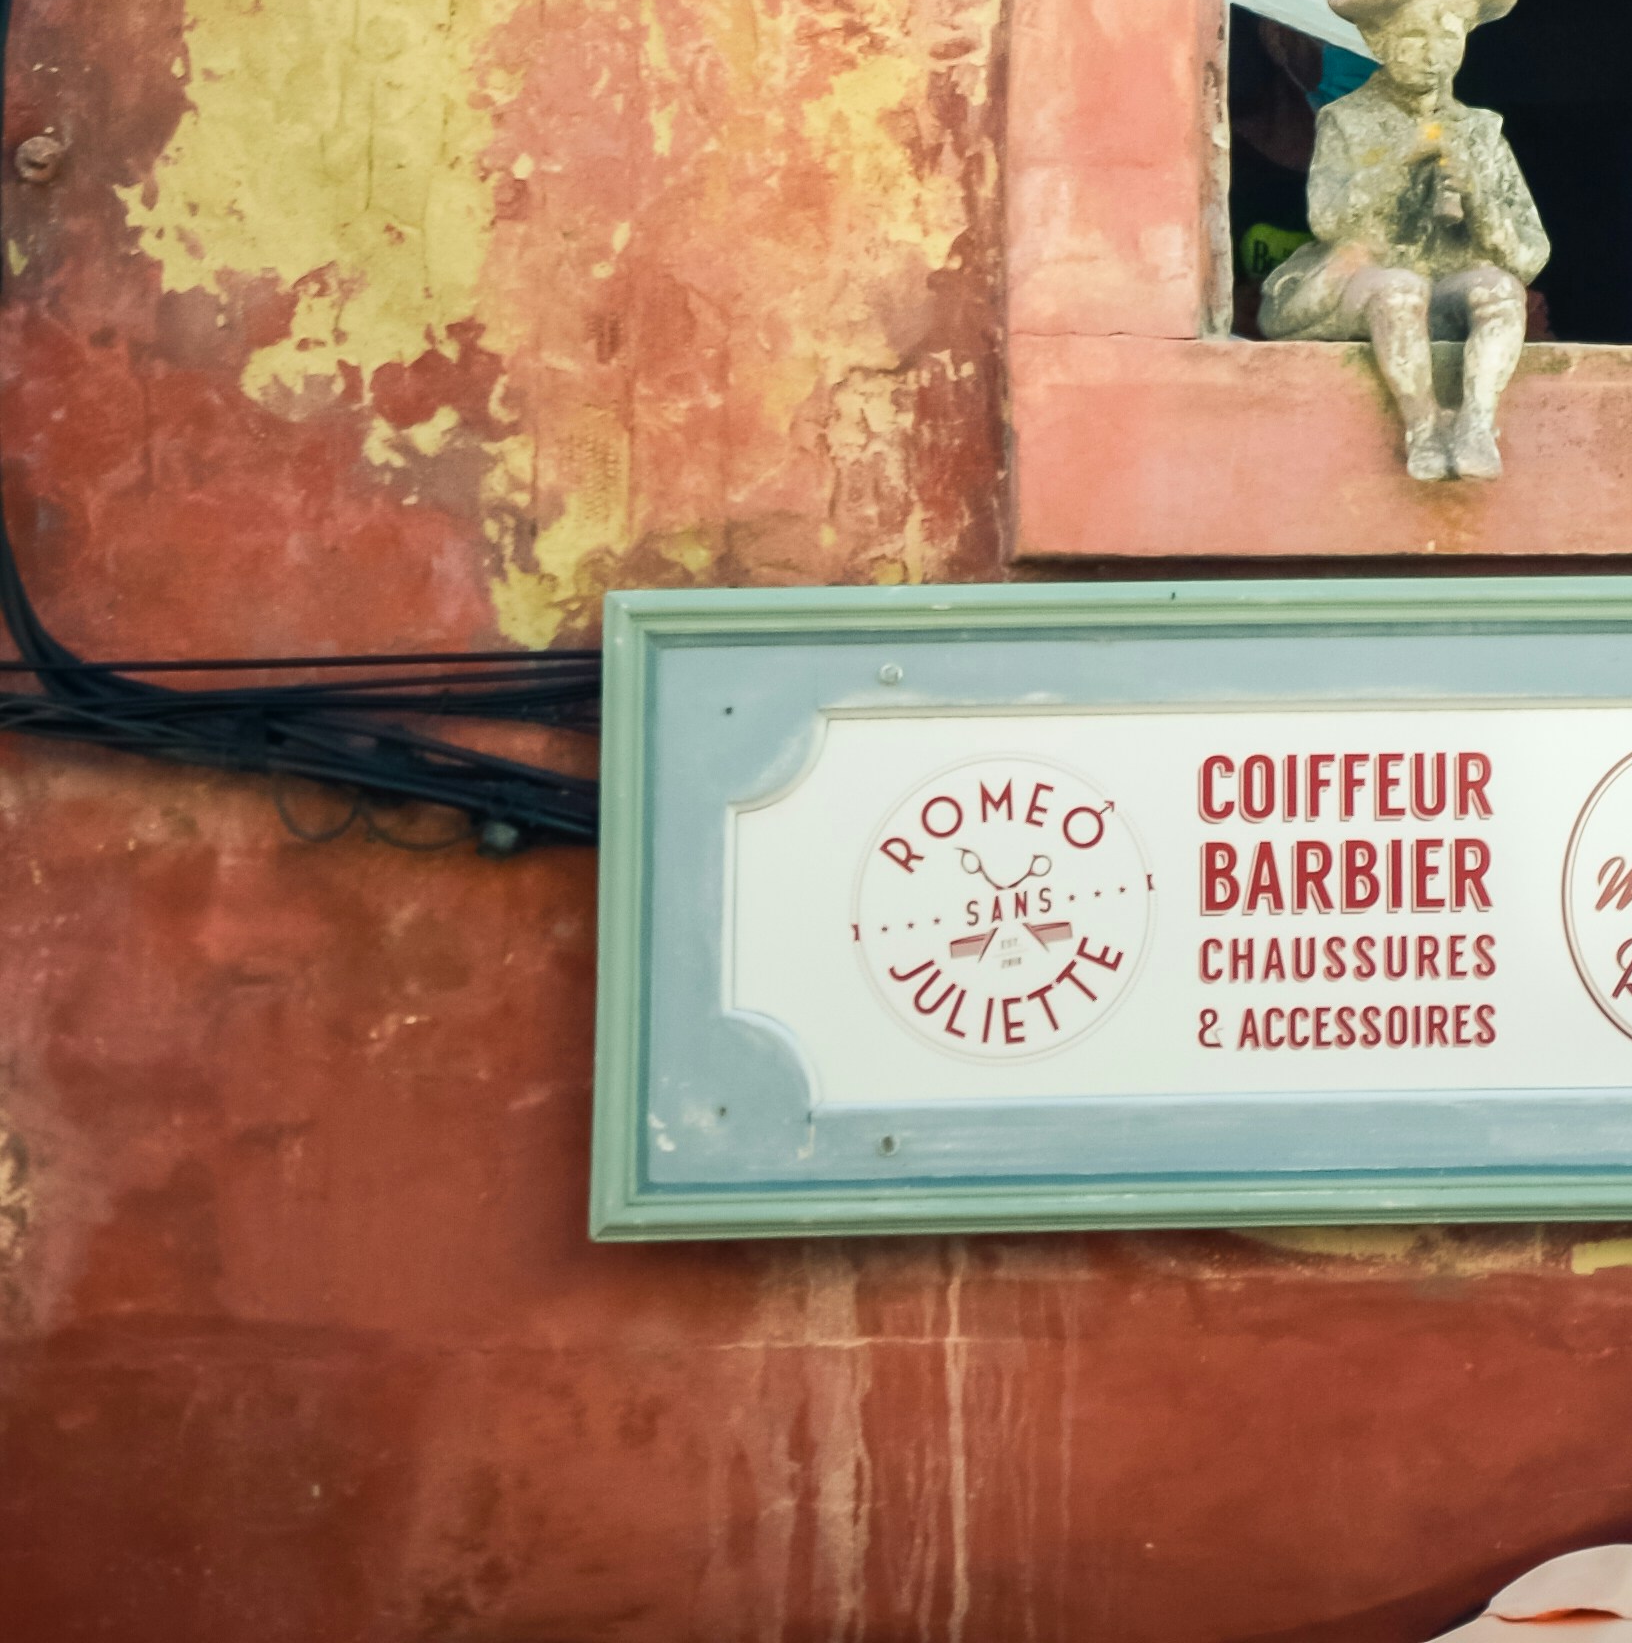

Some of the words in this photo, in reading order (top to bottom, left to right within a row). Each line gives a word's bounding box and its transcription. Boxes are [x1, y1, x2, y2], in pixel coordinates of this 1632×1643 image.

[1198, 751, 1495, 824] COIFFEUR
[881, 779, 1105, 873] ROMEO
[966, 887, 1052, 927] SANS
[1200, 838, 1494, 917] BARBIER
[889, 937, 1123, 1044] JULIETTE
[1199, 933, 1498, 984] CHAUSSURES
[1199, 1009, 1223, 1049] &
[1237, 1003, 1498, 1051] ACCESSOIRES
